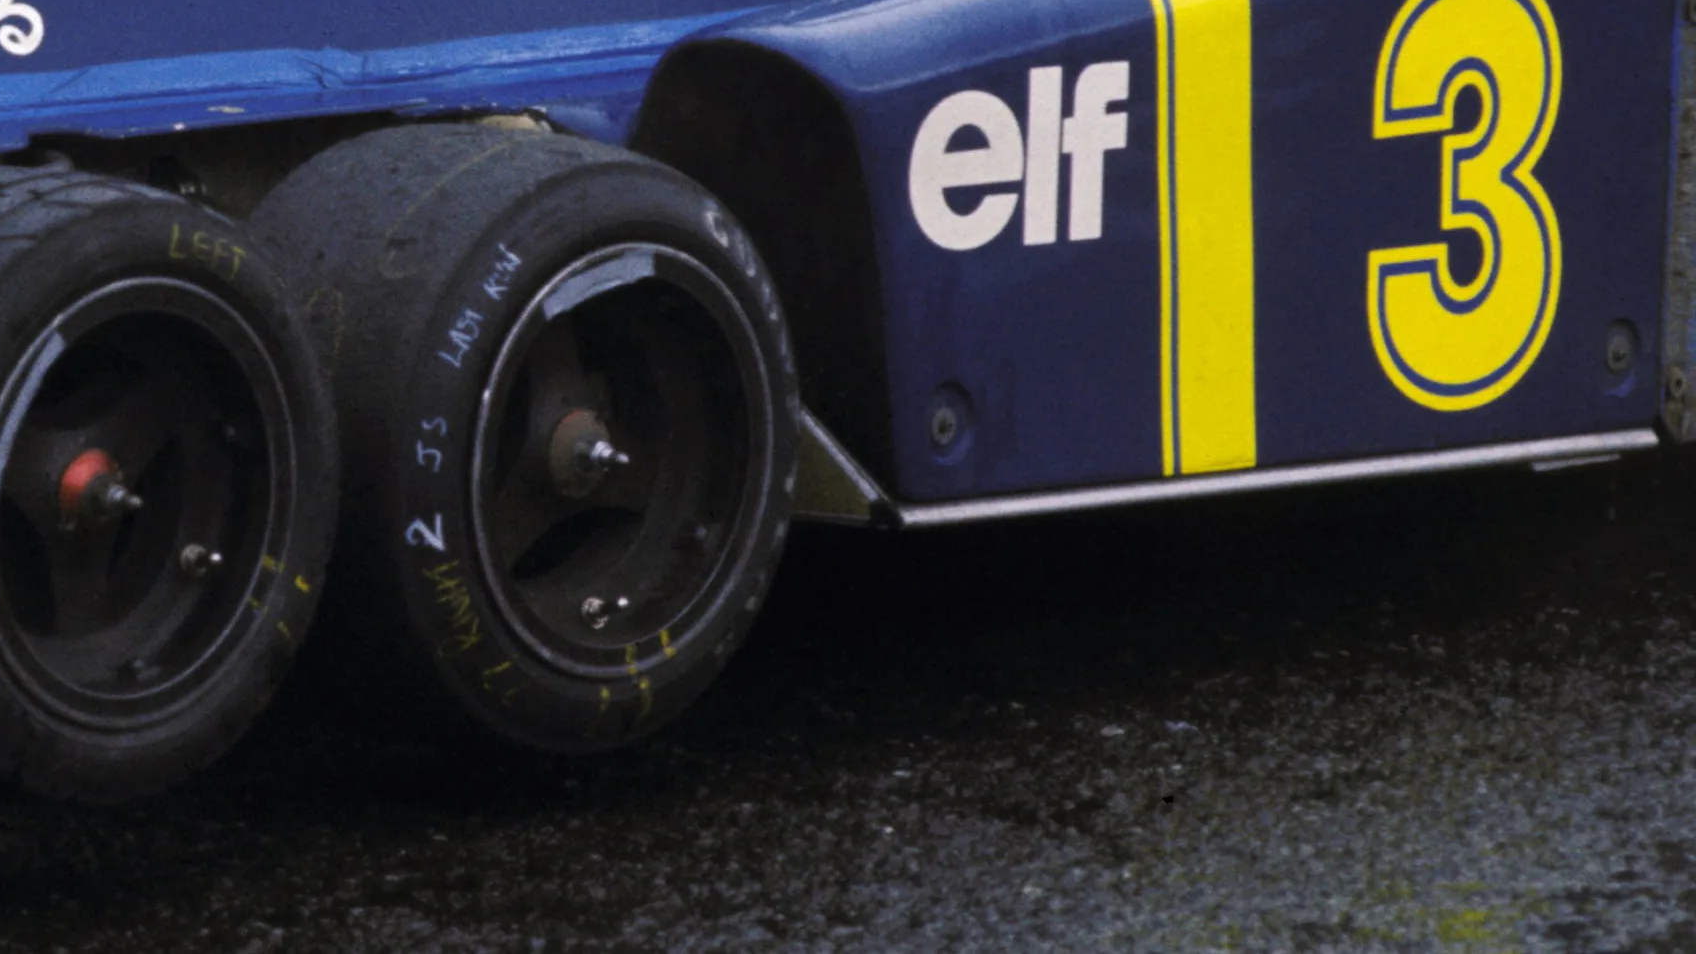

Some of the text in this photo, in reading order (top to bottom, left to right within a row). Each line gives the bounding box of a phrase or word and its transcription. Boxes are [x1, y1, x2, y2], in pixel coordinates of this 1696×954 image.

[908, 60, 1130, 252] elf
[169, 221, 248, 282] LEFT
[404, 512, 447, 552] 2
